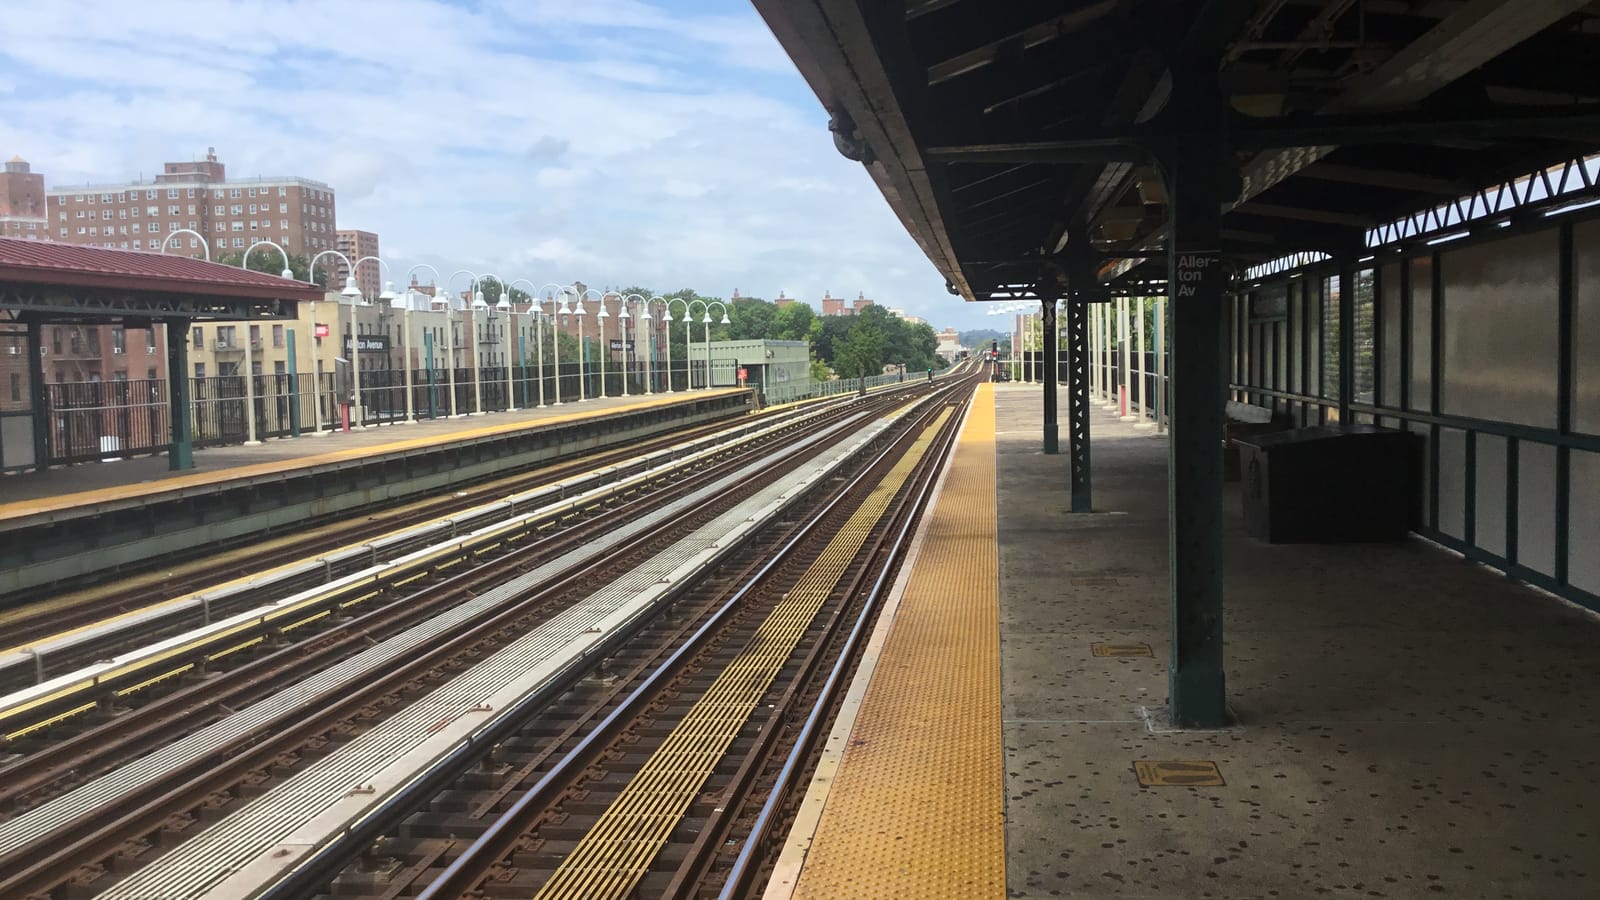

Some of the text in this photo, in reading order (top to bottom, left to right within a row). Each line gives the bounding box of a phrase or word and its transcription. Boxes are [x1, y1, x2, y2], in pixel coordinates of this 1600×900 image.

[1177, 255, 1219, 268] Aller-
[1177, 269, 1202, 281] ton
[1178, 284, 1196, 296] Av
[367, 339, 383, 349] Avenue
